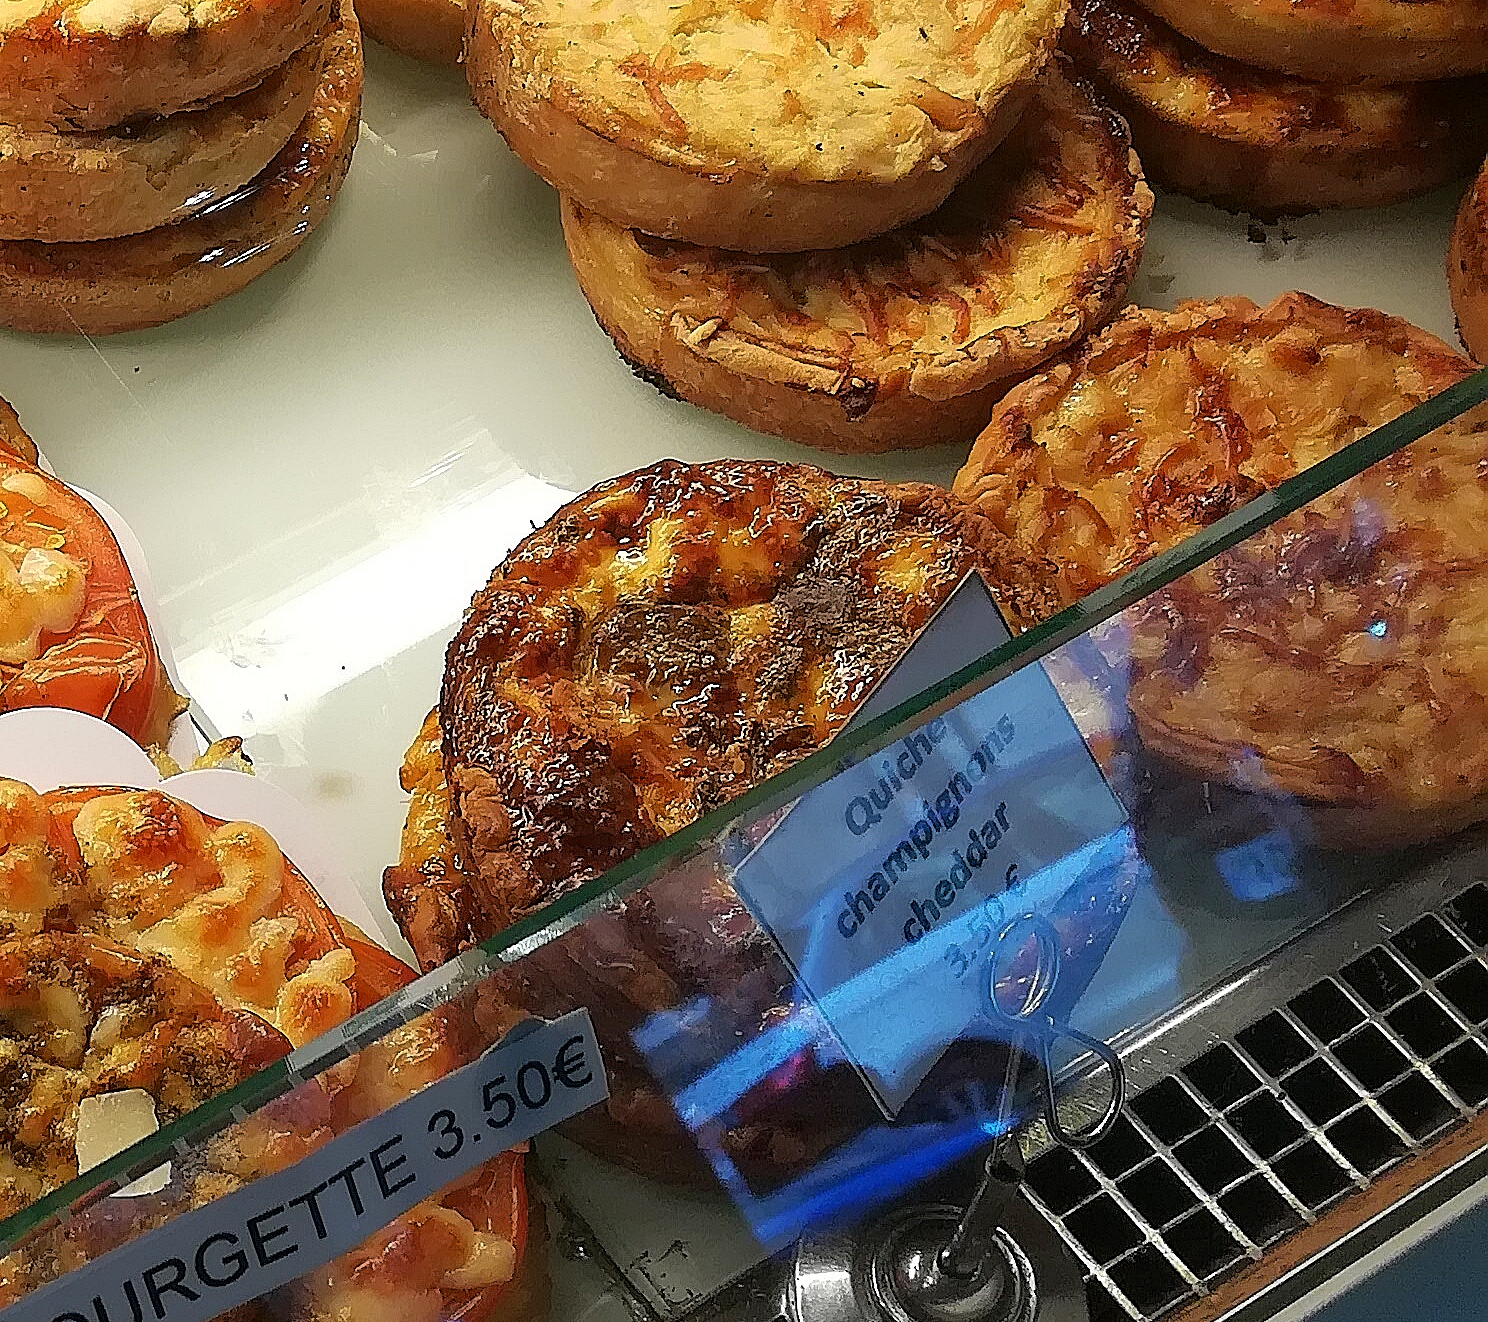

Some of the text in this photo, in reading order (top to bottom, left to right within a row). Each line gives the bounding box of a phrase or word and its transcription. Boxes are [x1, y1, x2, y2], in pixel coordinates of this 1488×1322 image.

[835, 712, 1016, 941] champignons
[844, 716, 947, 837] Quiche
[903, 799, 1011, 945] cheddar
[424, 1034, 597, 1161] 3.50€
